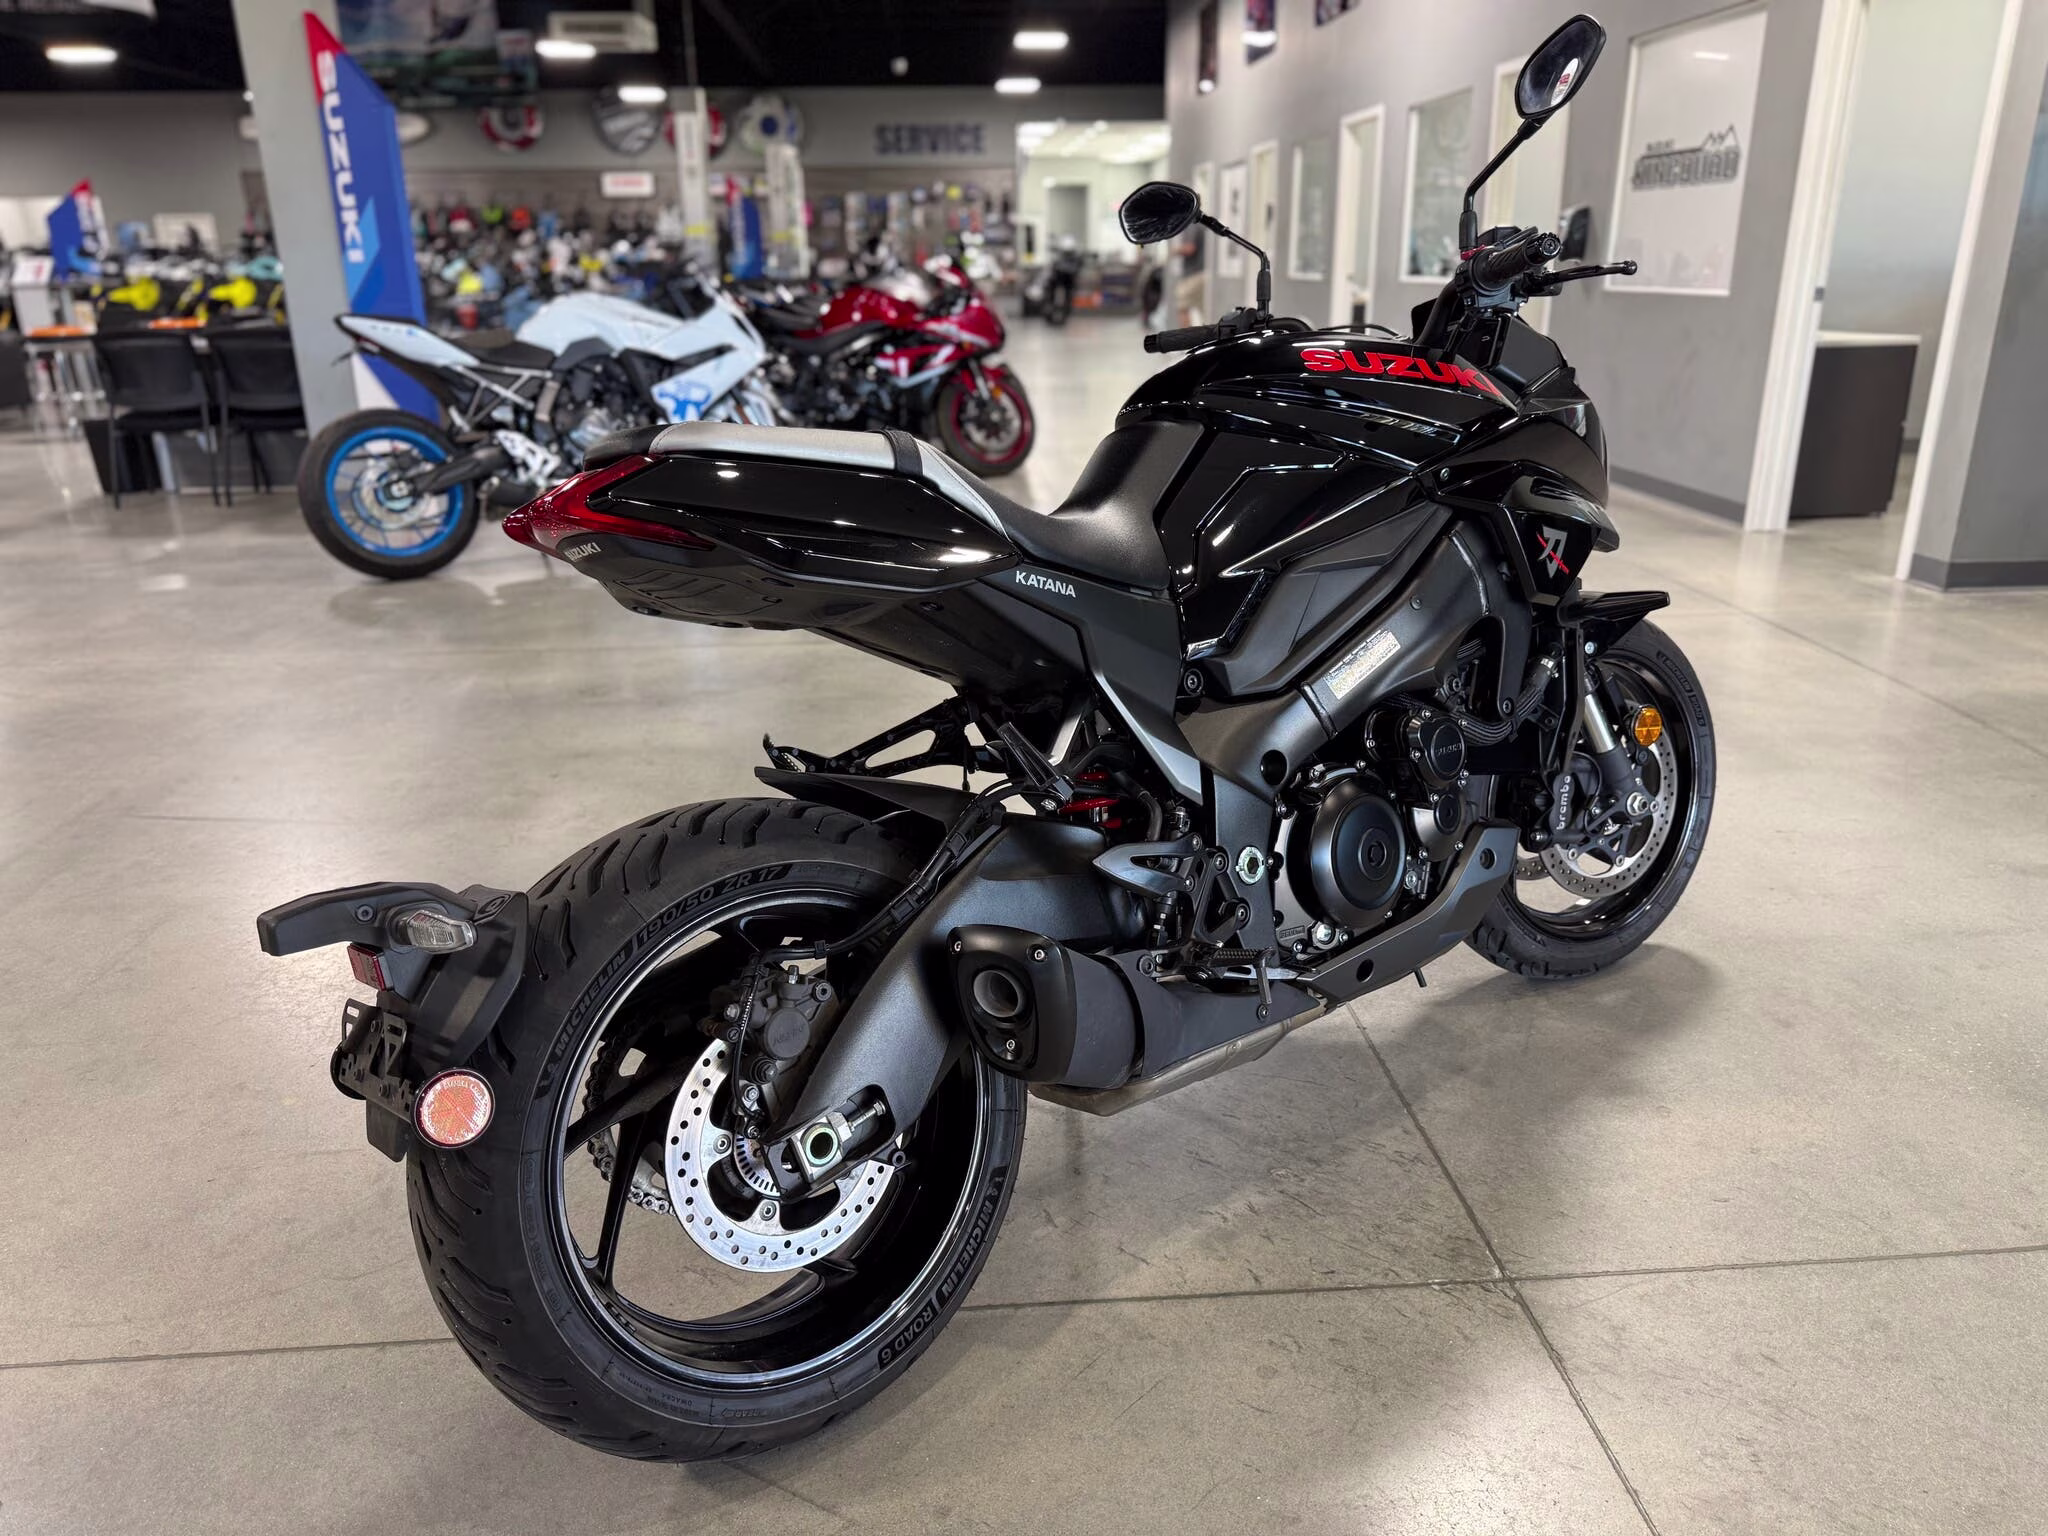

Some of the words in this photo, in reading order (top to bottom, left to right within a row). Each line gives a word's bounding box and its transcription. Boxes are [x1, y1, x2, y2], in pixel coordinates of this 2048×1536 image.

[317, 50, 365, 263] SUZUKI
[874, 123, 986, 156] SERVICE
[1300, 347, 1503, 399] SUZUKI
[1015, 570, 1077, 598] KATANA
[1556, 775, 1571, 830] brembo
[554, 950, 628, 1056] MICHELIN
[639, 887, 714, 944] 190/50
[722, 873, 752, 892] ZR
[758, 867, 782, 882] 17
[941, 1203, 994, 1298] MICHELIN
[894, 1306, 934, 1349] ROAD
[881, 1348, 893, 1364] 6
